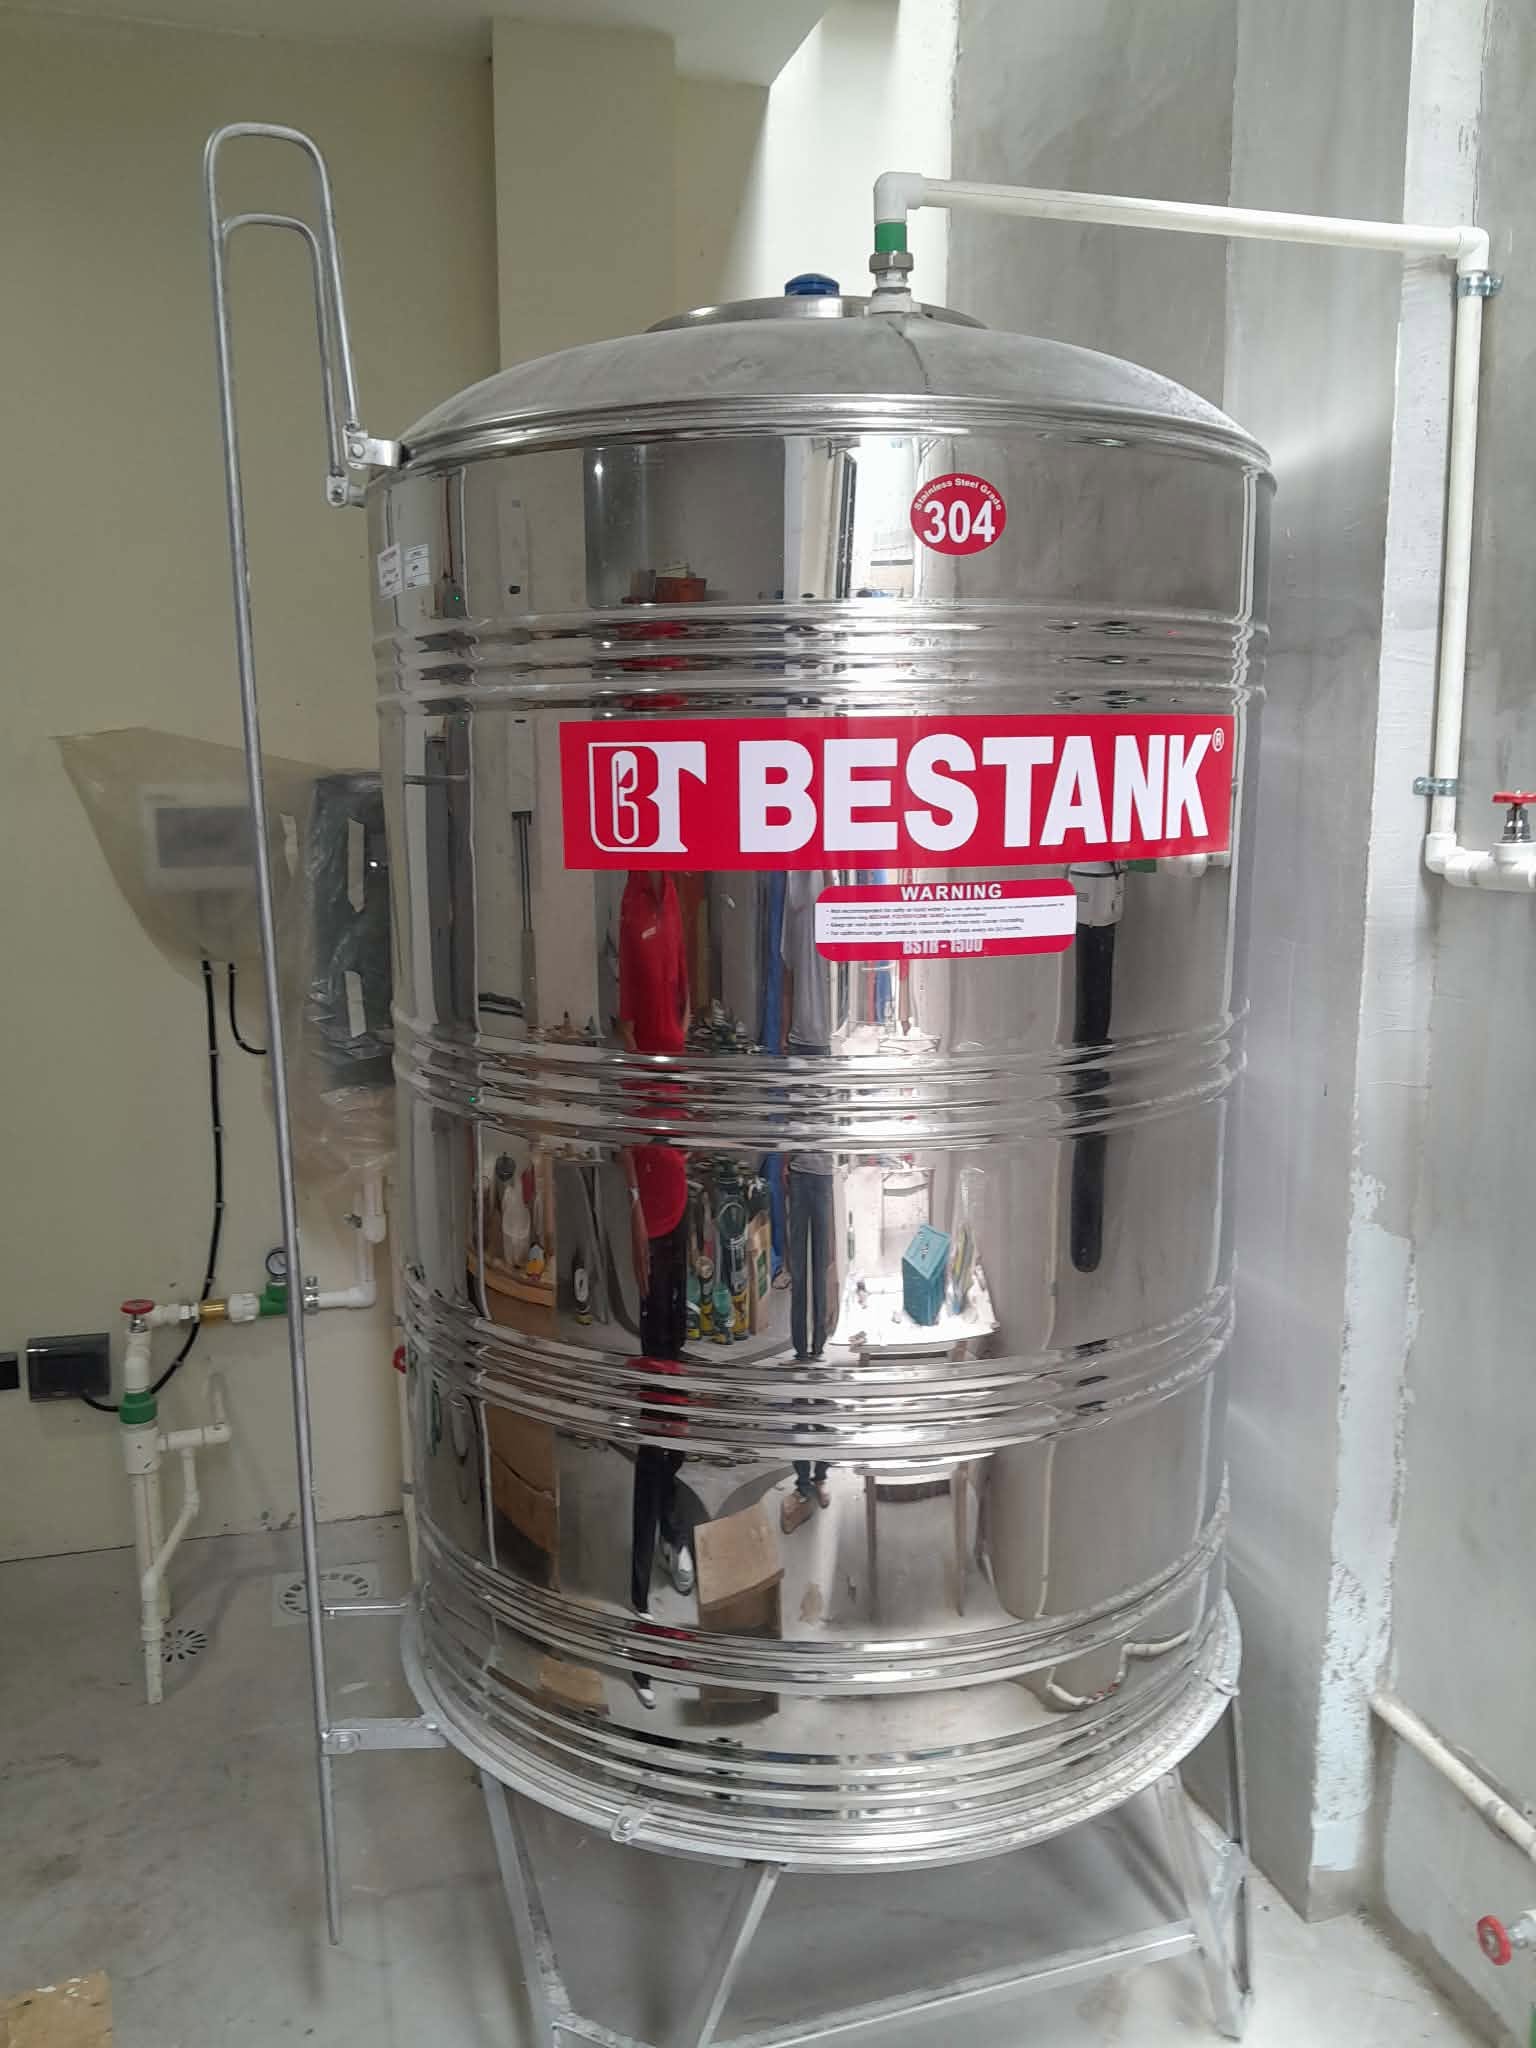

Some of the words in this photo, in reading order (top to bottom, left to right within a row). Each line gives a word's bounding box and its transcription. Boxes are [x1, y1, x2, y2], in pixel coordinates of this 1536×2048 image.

[913, 480, 953, 511] Stainless
[955, 478, 979, 489] Steel
[980, 484, 1002, 511] Grade
[923, 500, 996, 544] 304
[901, 883, 1003, 901] WARNING
